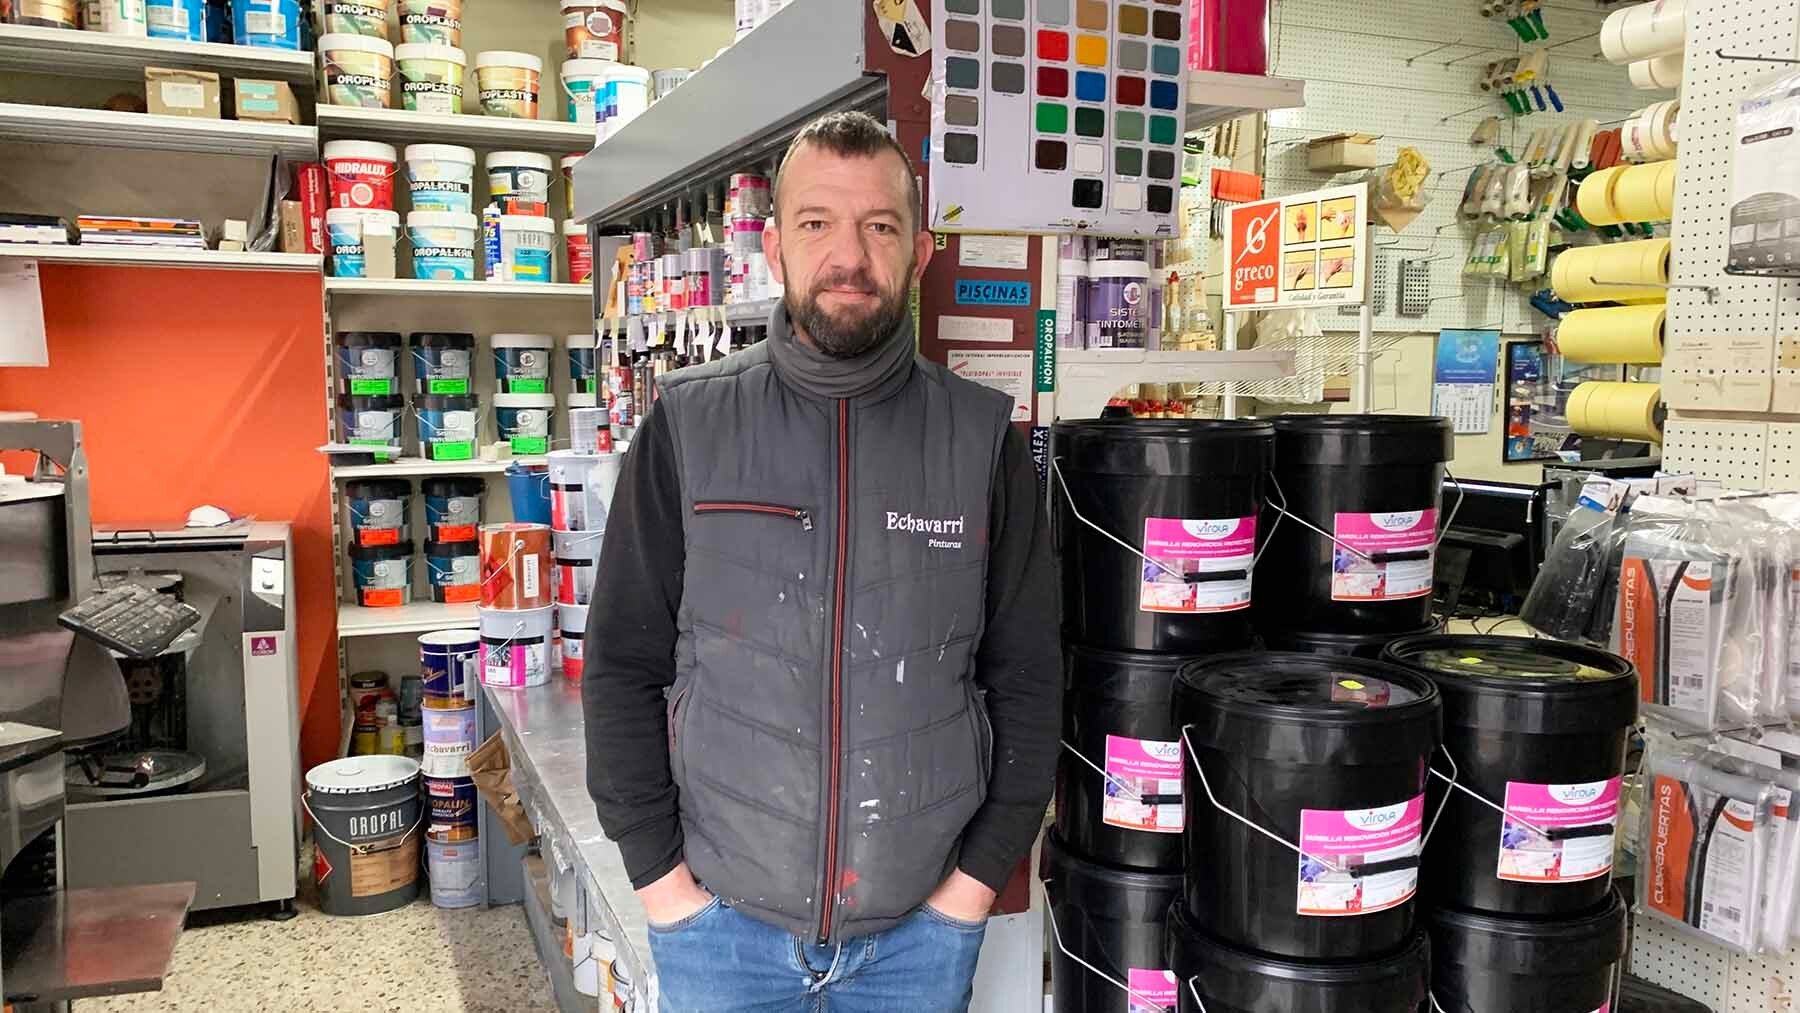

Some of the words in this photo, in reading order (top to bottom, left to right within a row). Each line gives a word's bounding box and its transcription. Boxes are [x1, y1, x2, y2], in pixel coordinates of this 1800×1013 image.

[335, 162, 387, 176] HIDRALUX
[1234, 264, 1274, 291] greco
[959, 285, 1028, 299] PISCINAS
[1044, 318, 1054, 385] OROPALHON
[886, 511, 964, 533] Echavarri
[928, 539, 962, 549] Pinturas
[350, 808, 404, 836] OROPAL
[1654, 784, 1672, 904] CUBREPUERTAS
